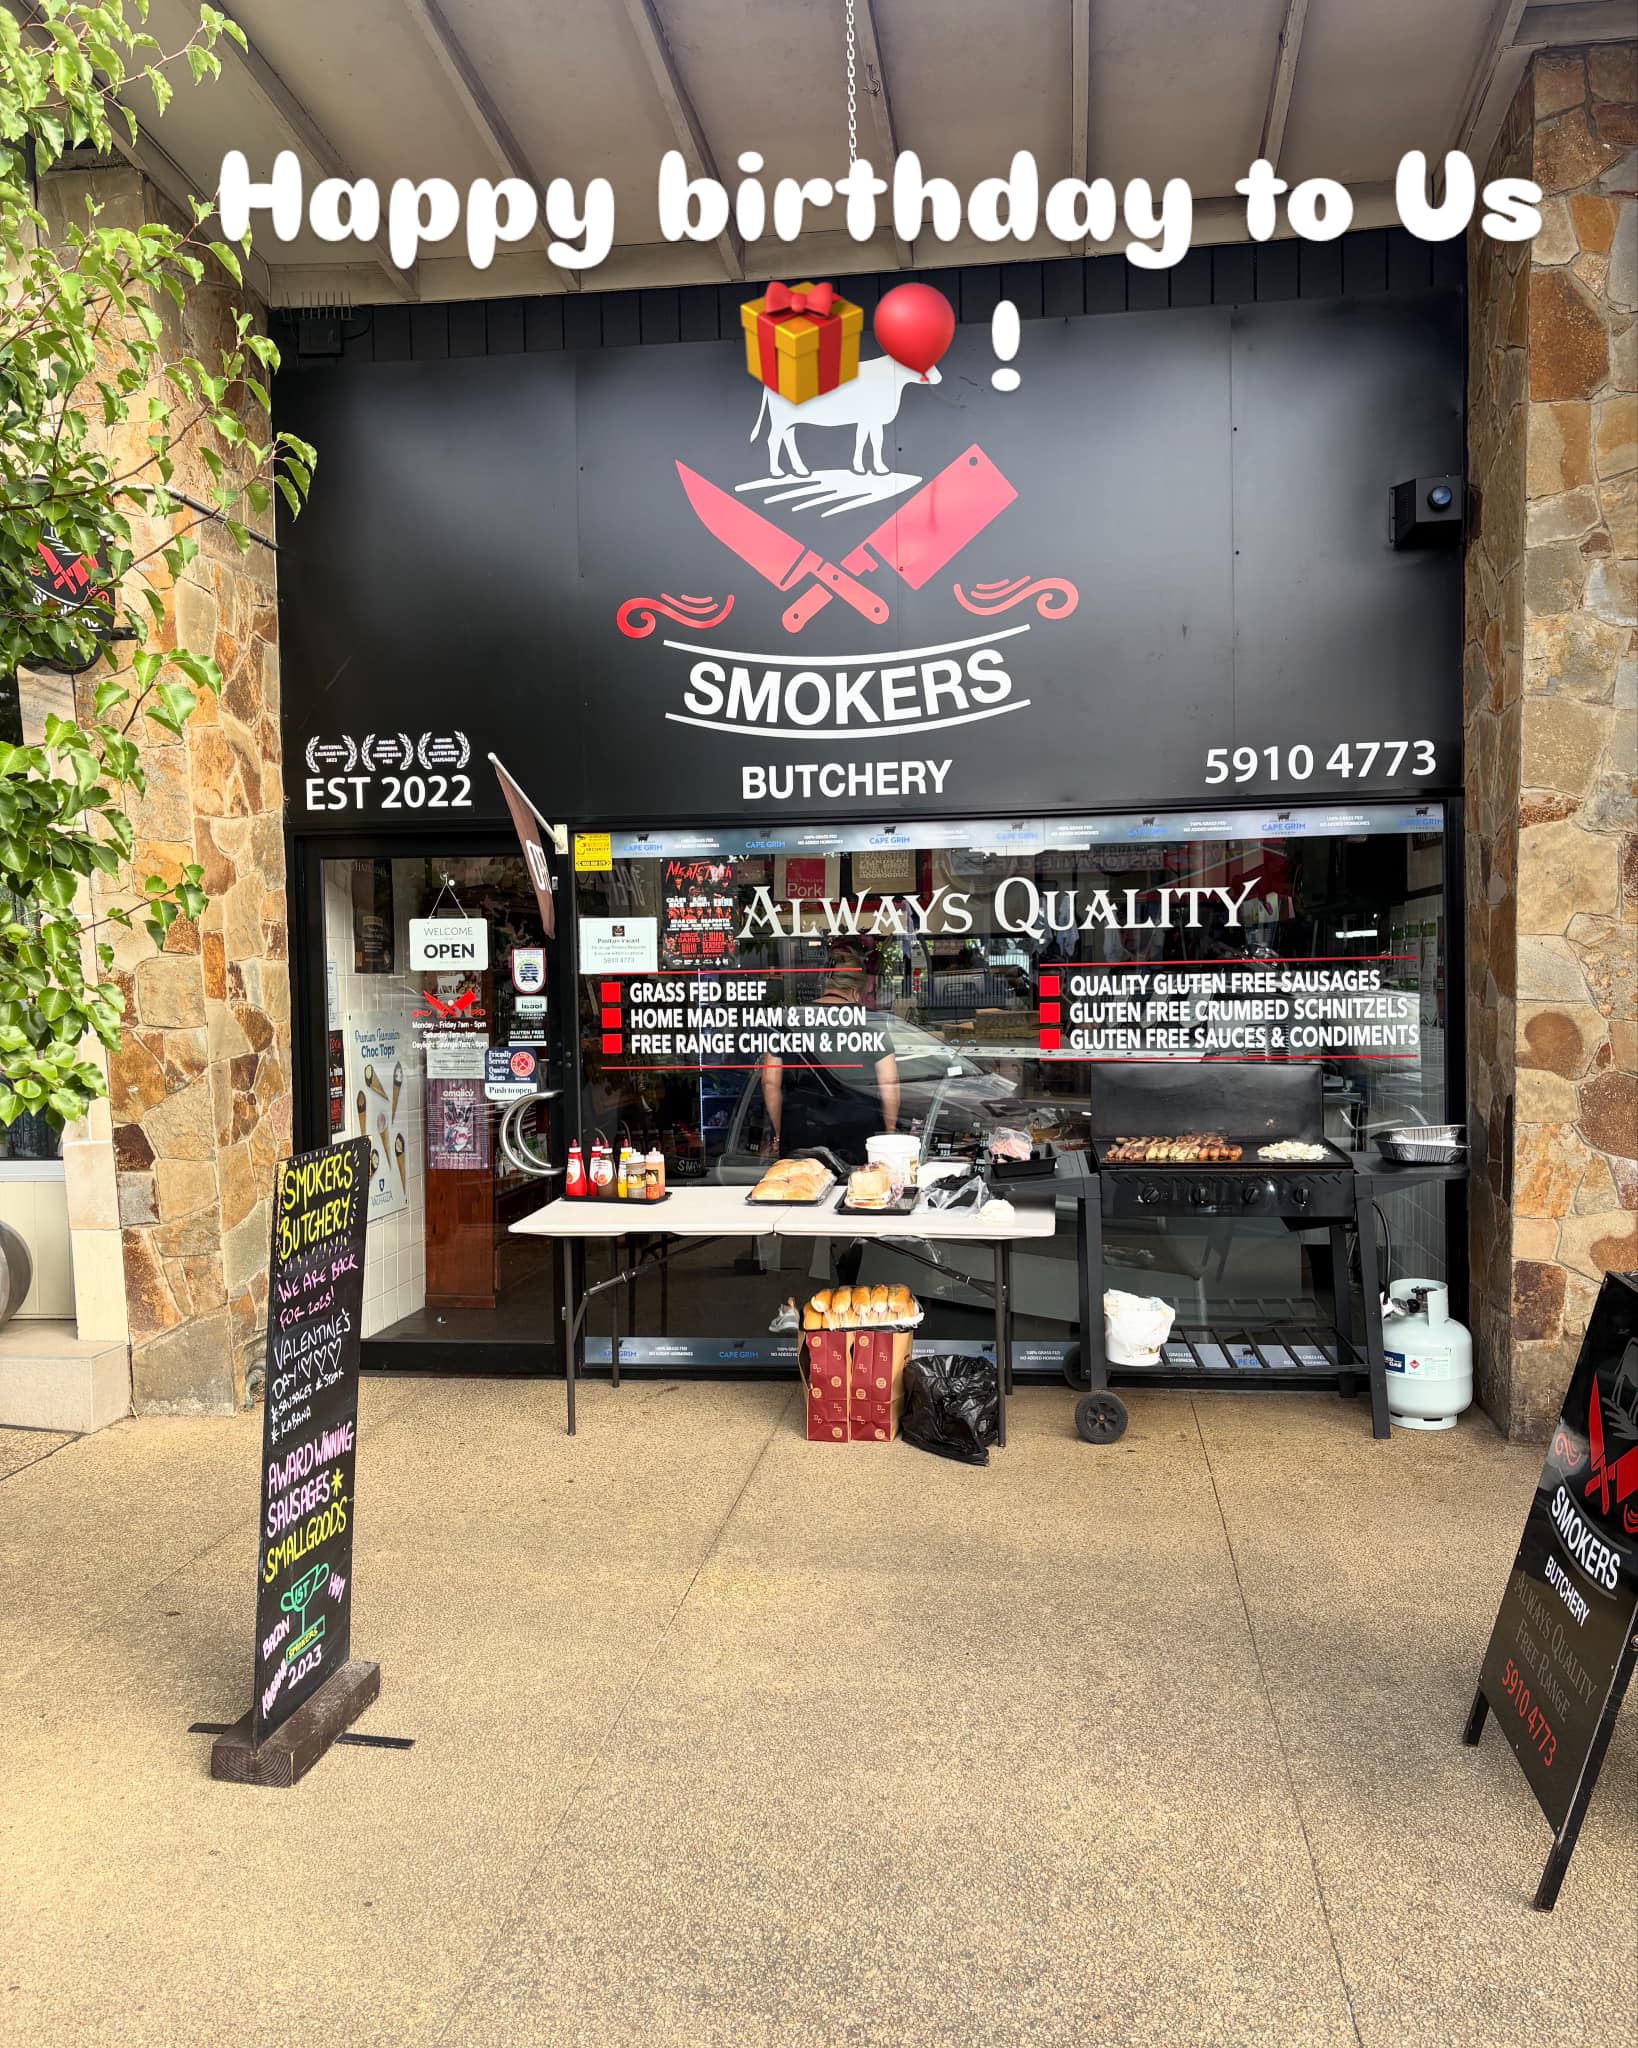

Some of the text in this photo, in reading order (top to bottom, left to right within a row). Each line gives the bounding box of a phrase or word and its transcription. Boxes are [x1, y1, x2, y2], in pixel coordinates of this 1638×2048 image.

[684, 648, 1013, 729] SMOKERS
[741, 758, 953, 800] BUTCHERY
[1204, 740, 1437, 785] 5910 4773
[306, 774, 472, 811] EST 2022
[787, 882, 822, 897] Pork
[735, 876, 1262, 941] ALWAYS QUALITY
[423, 926, 473, 936] WELCOME
[423, 943, 475, 959] OPEN
[629, 981, 767, 1003] GRASS FED BEEF
[1069, 969, 1381, 997] QUALITY GLUTEN FREE SAUSAGES
[412, 1021, 434, 1030] Monday
[439, 1020, 457, 1030] Friday
[630, 1006, 867, 1029] HOME MADE HAM & BACON
[1069, 997, 1408, 1023] GLUTEN FREE CRUMBED SCHNITZELS
[361, 1043, 395, 1059] Choc Tops
[422, 1031, 448, 1039] Saturday
[631, 1031, 886, 1055] FREE RANGE CHICKEN & PORK
[1069, 1024, 1420, 1050] GLUTEN FREE SAUCES & CONDIMENTS
[488, 1050, 511, 1059] Friendly
[488, 1066, 509, 1074] Quality
[488, 1073, 506, 1081] Meats
[489, 1086, 507, 1094] Push
[283, 1150, 353, 1212] SMOKERS
[279, 1191, 351, 1261] BUTCHERY
[277, 1253, 359, 1305] WE ARE BACK
[279, 1307, 305, 1333] FOR
[274, 1308, 352, 1371] VALENTINE'S
[281, 1405, 312, 1439] KABANA
[267, 1420, 355, 1500] AWARD WINNING
[266, 1469, 331, 1539] SAUSAGES
[263, 1495, 348, 1584] SMALLGOODS
[1550, 1485, 1621, 1591] SMOKERS
[327, 1571, 346, 1603] HAM
[1544, 1555, 1591, 1628] BUTCHERY
[263, 1614, 291, 1661] BACON
[1513, 1570, 1599, 1705] ALWAYS QUALITY
[287, 1643, 323, 1691] 2023
[1515, 1617, 1571, 1724] FREE RANGE
[1501, 1658, 1559, 1767] 5910 4773
